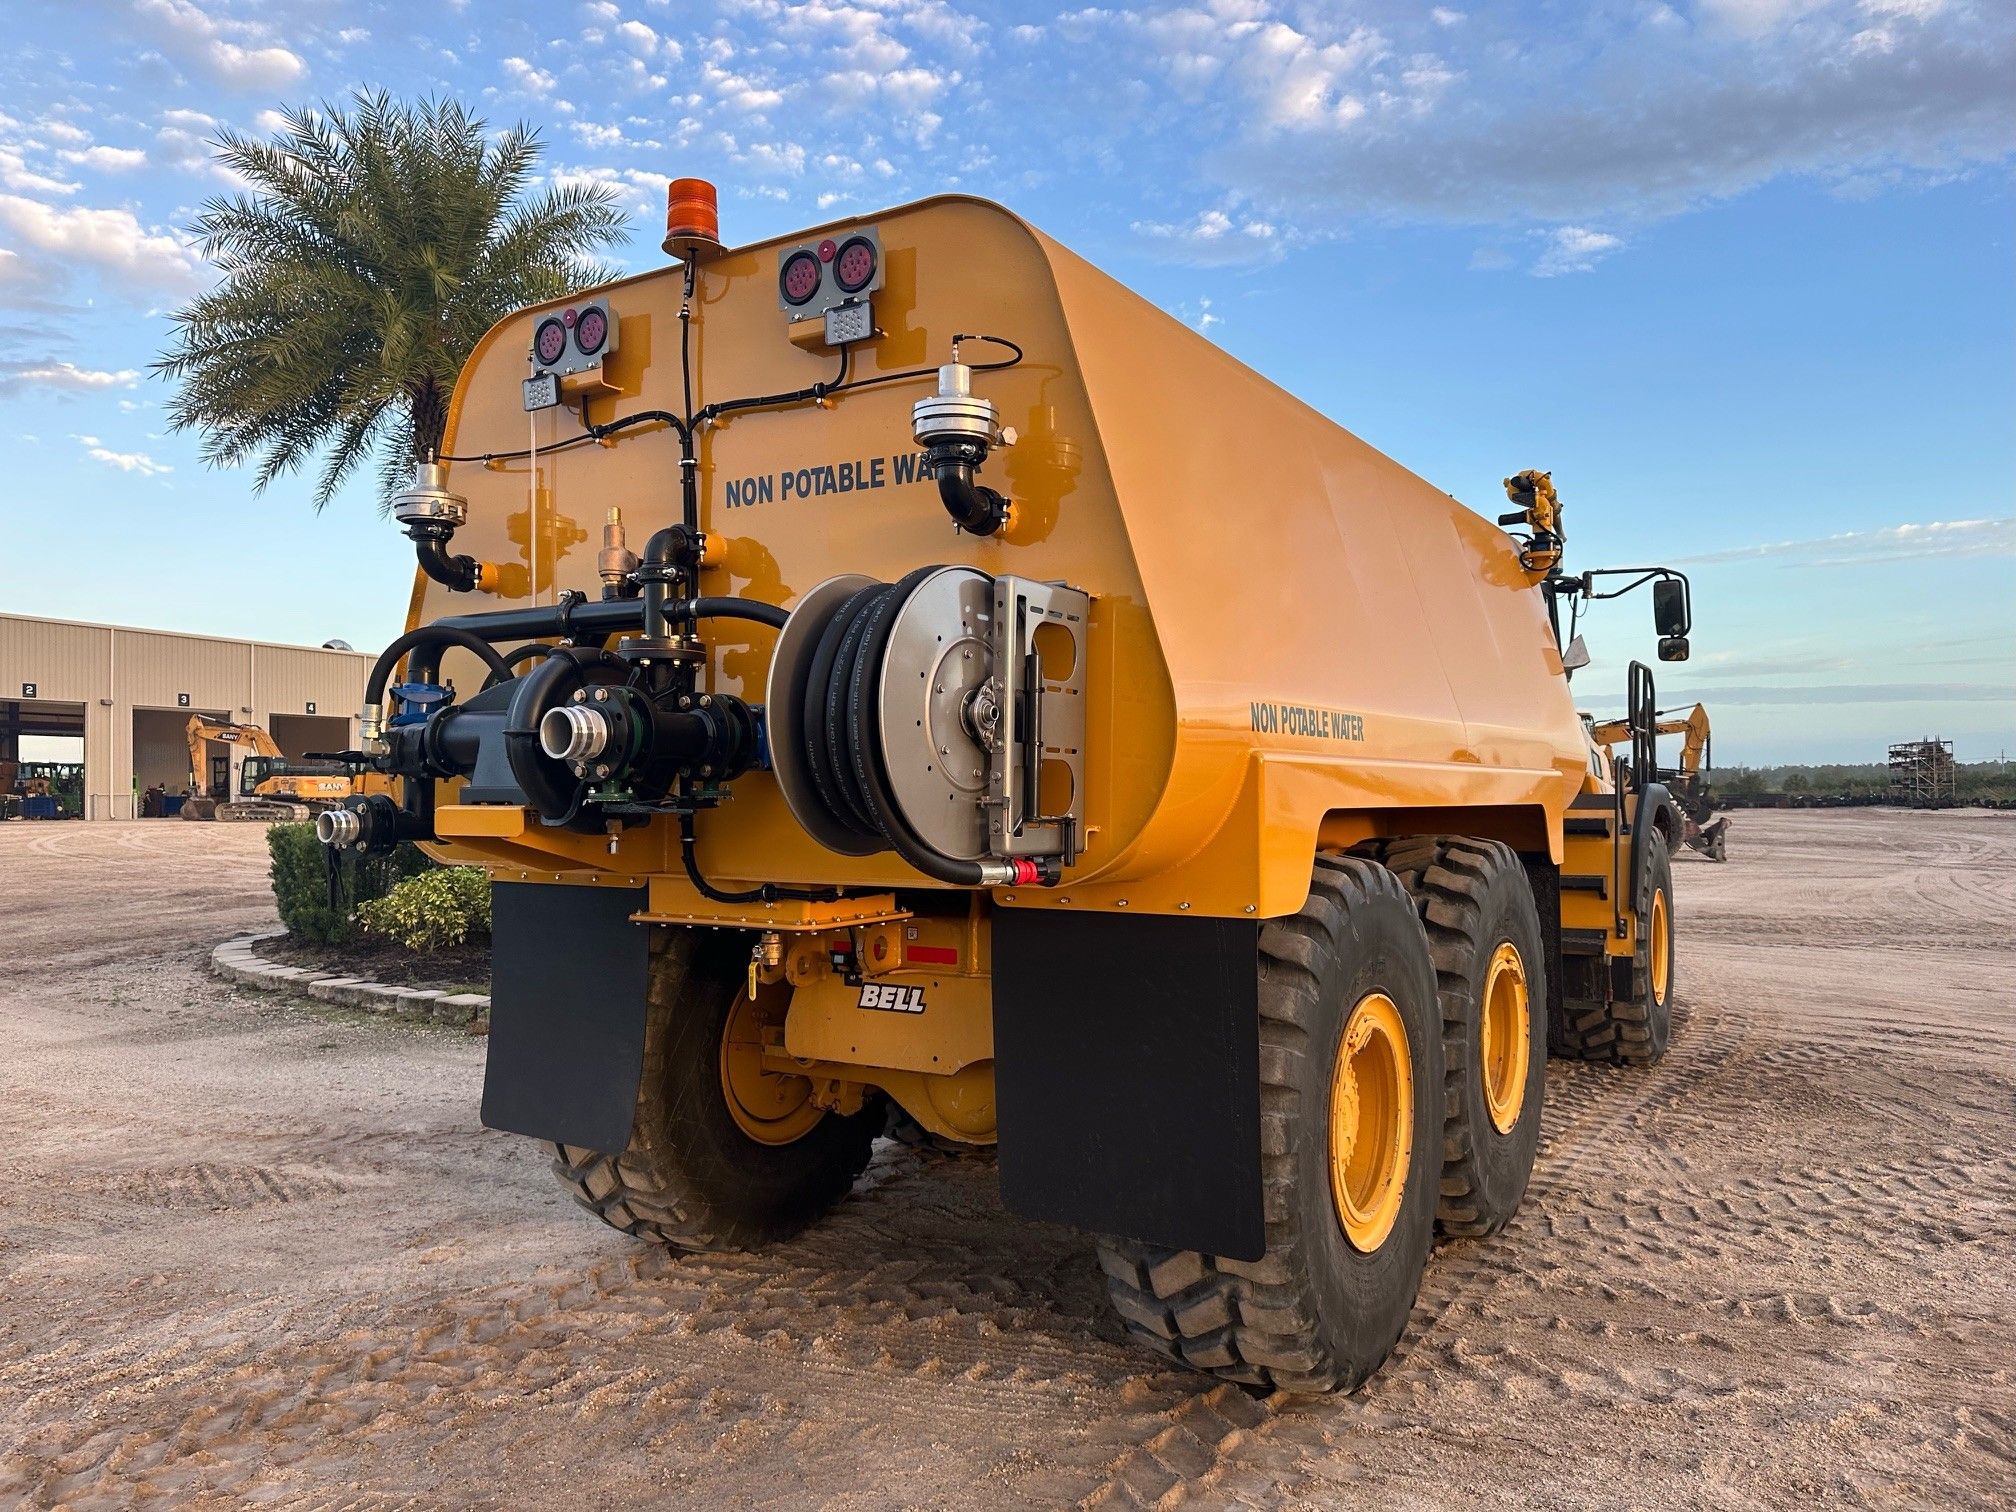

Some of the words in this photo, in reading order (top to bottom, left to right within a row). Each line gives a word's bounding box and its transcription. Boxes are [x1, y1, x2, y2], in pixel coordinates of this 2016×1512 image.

[726, 474, 773, 509] NON
[781, 457, 885, 502] POTABLE
[26, 685, 34, 695] 2
[180, 695, 187, 704] 3
[1250, 701, 1278, 733] NON
[1281, 705, 1330, 738] POTABLE
[1331, 711, 1365, 742] WATER
[317, 782, 344, 792] SANY
[859, 984, 926, 1012] BELL
